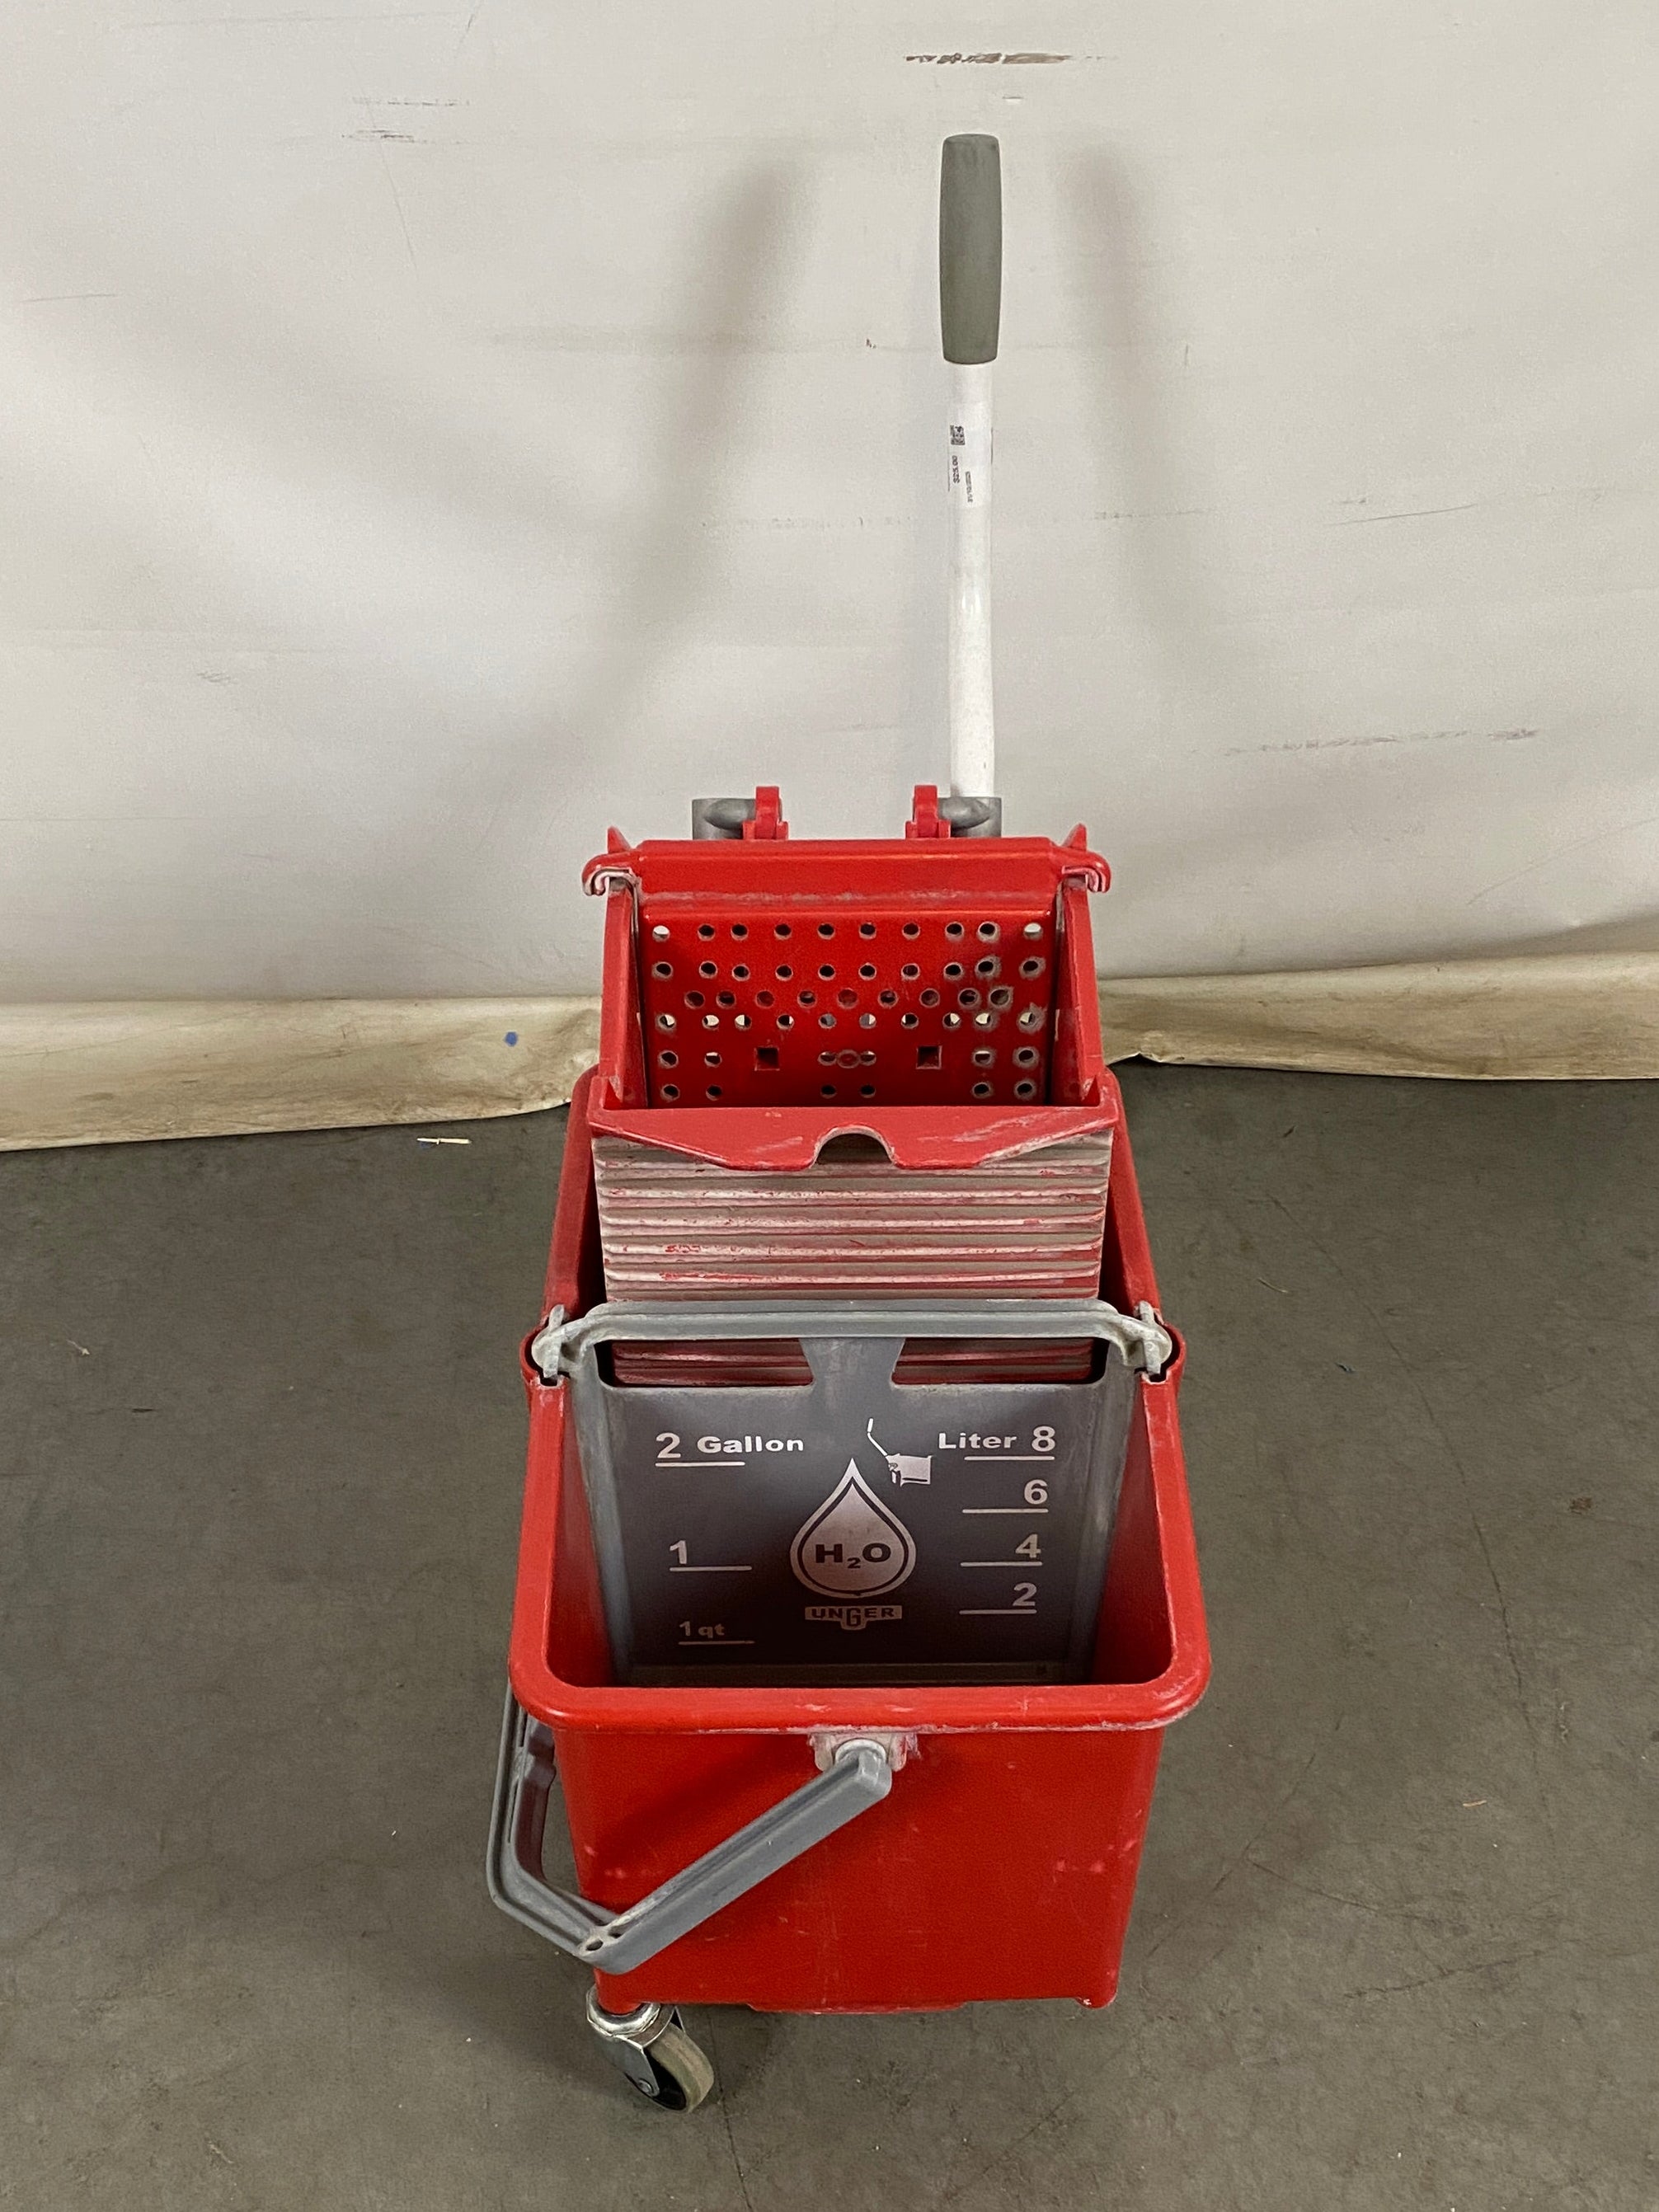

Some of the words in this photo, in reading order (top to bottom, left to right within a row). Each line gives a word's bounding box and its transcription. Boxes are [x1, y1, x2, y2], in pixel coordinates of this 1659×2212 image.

[656, 1432, 681, 1458] 2
[697, 1435, 805, 1454] Gallon
[938, 1431, 1017, 1449] Liter
[1032, 1425, 1056, 1453] 8
[1024, 1479, 1049, 1505] 6
[669, 1540, 688, 1565] 1
[1015, 1533, 1041, 1559] 4
[1013, 1582, 1038, 1607] 2
[811, 1607, 895, 1627] UNGER
[679, 1621, 692, 1637] 1
[698, 1623, 726, 1640] qt
